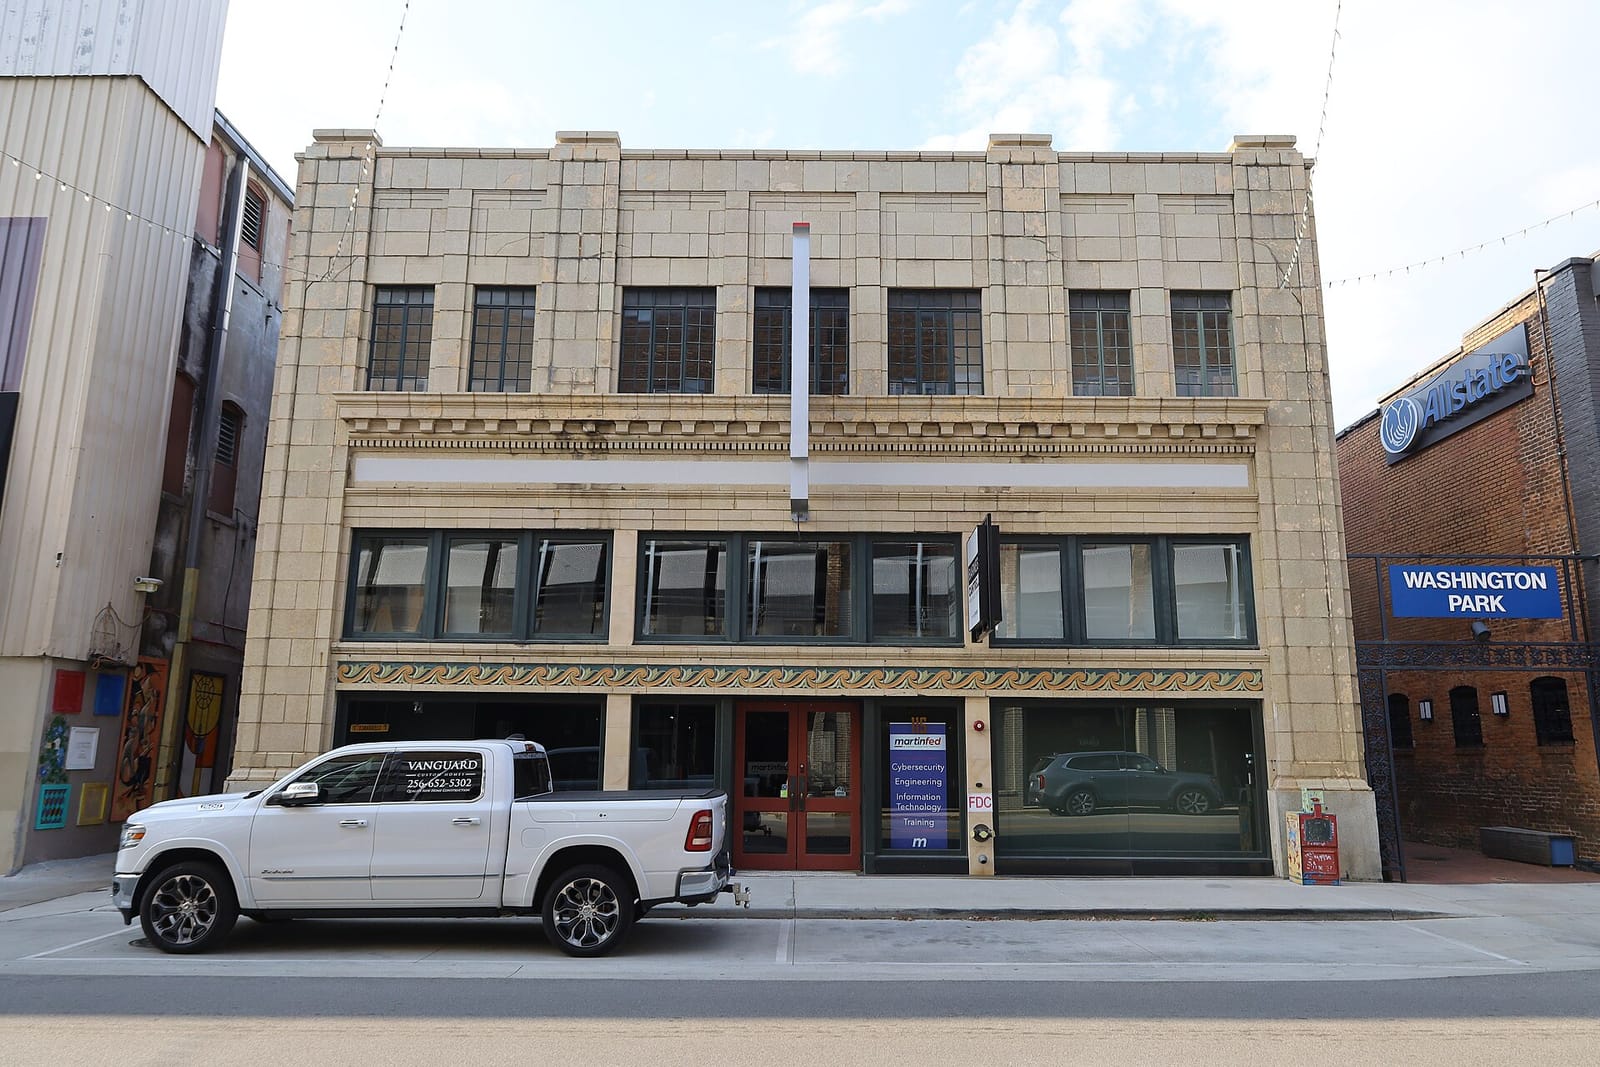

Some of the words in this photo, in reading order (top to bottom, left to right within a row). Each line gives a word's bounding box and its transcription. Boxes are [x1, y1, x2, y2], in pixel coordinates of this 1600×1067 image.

[1422, 353, 1520, 429] Allstate
[1403, 571, 1547, 590] WASHINGTON
[1448, 594, 1506, 613] PARK
[894, 737, 942, 746] martinfed
[408, 760, 478, 770] VANGUARD
[891, 762, 945, 773] Cybersecurity
[407, 779, 472, 788] 256-652-5302
[894, 777, 942, 788] Engineering
[896, 792, 941, 801] Information
[968, 796, 992, 808] FDC
[896, 803, 942, 813] Technology
[903, 817, 935, 828] Training
